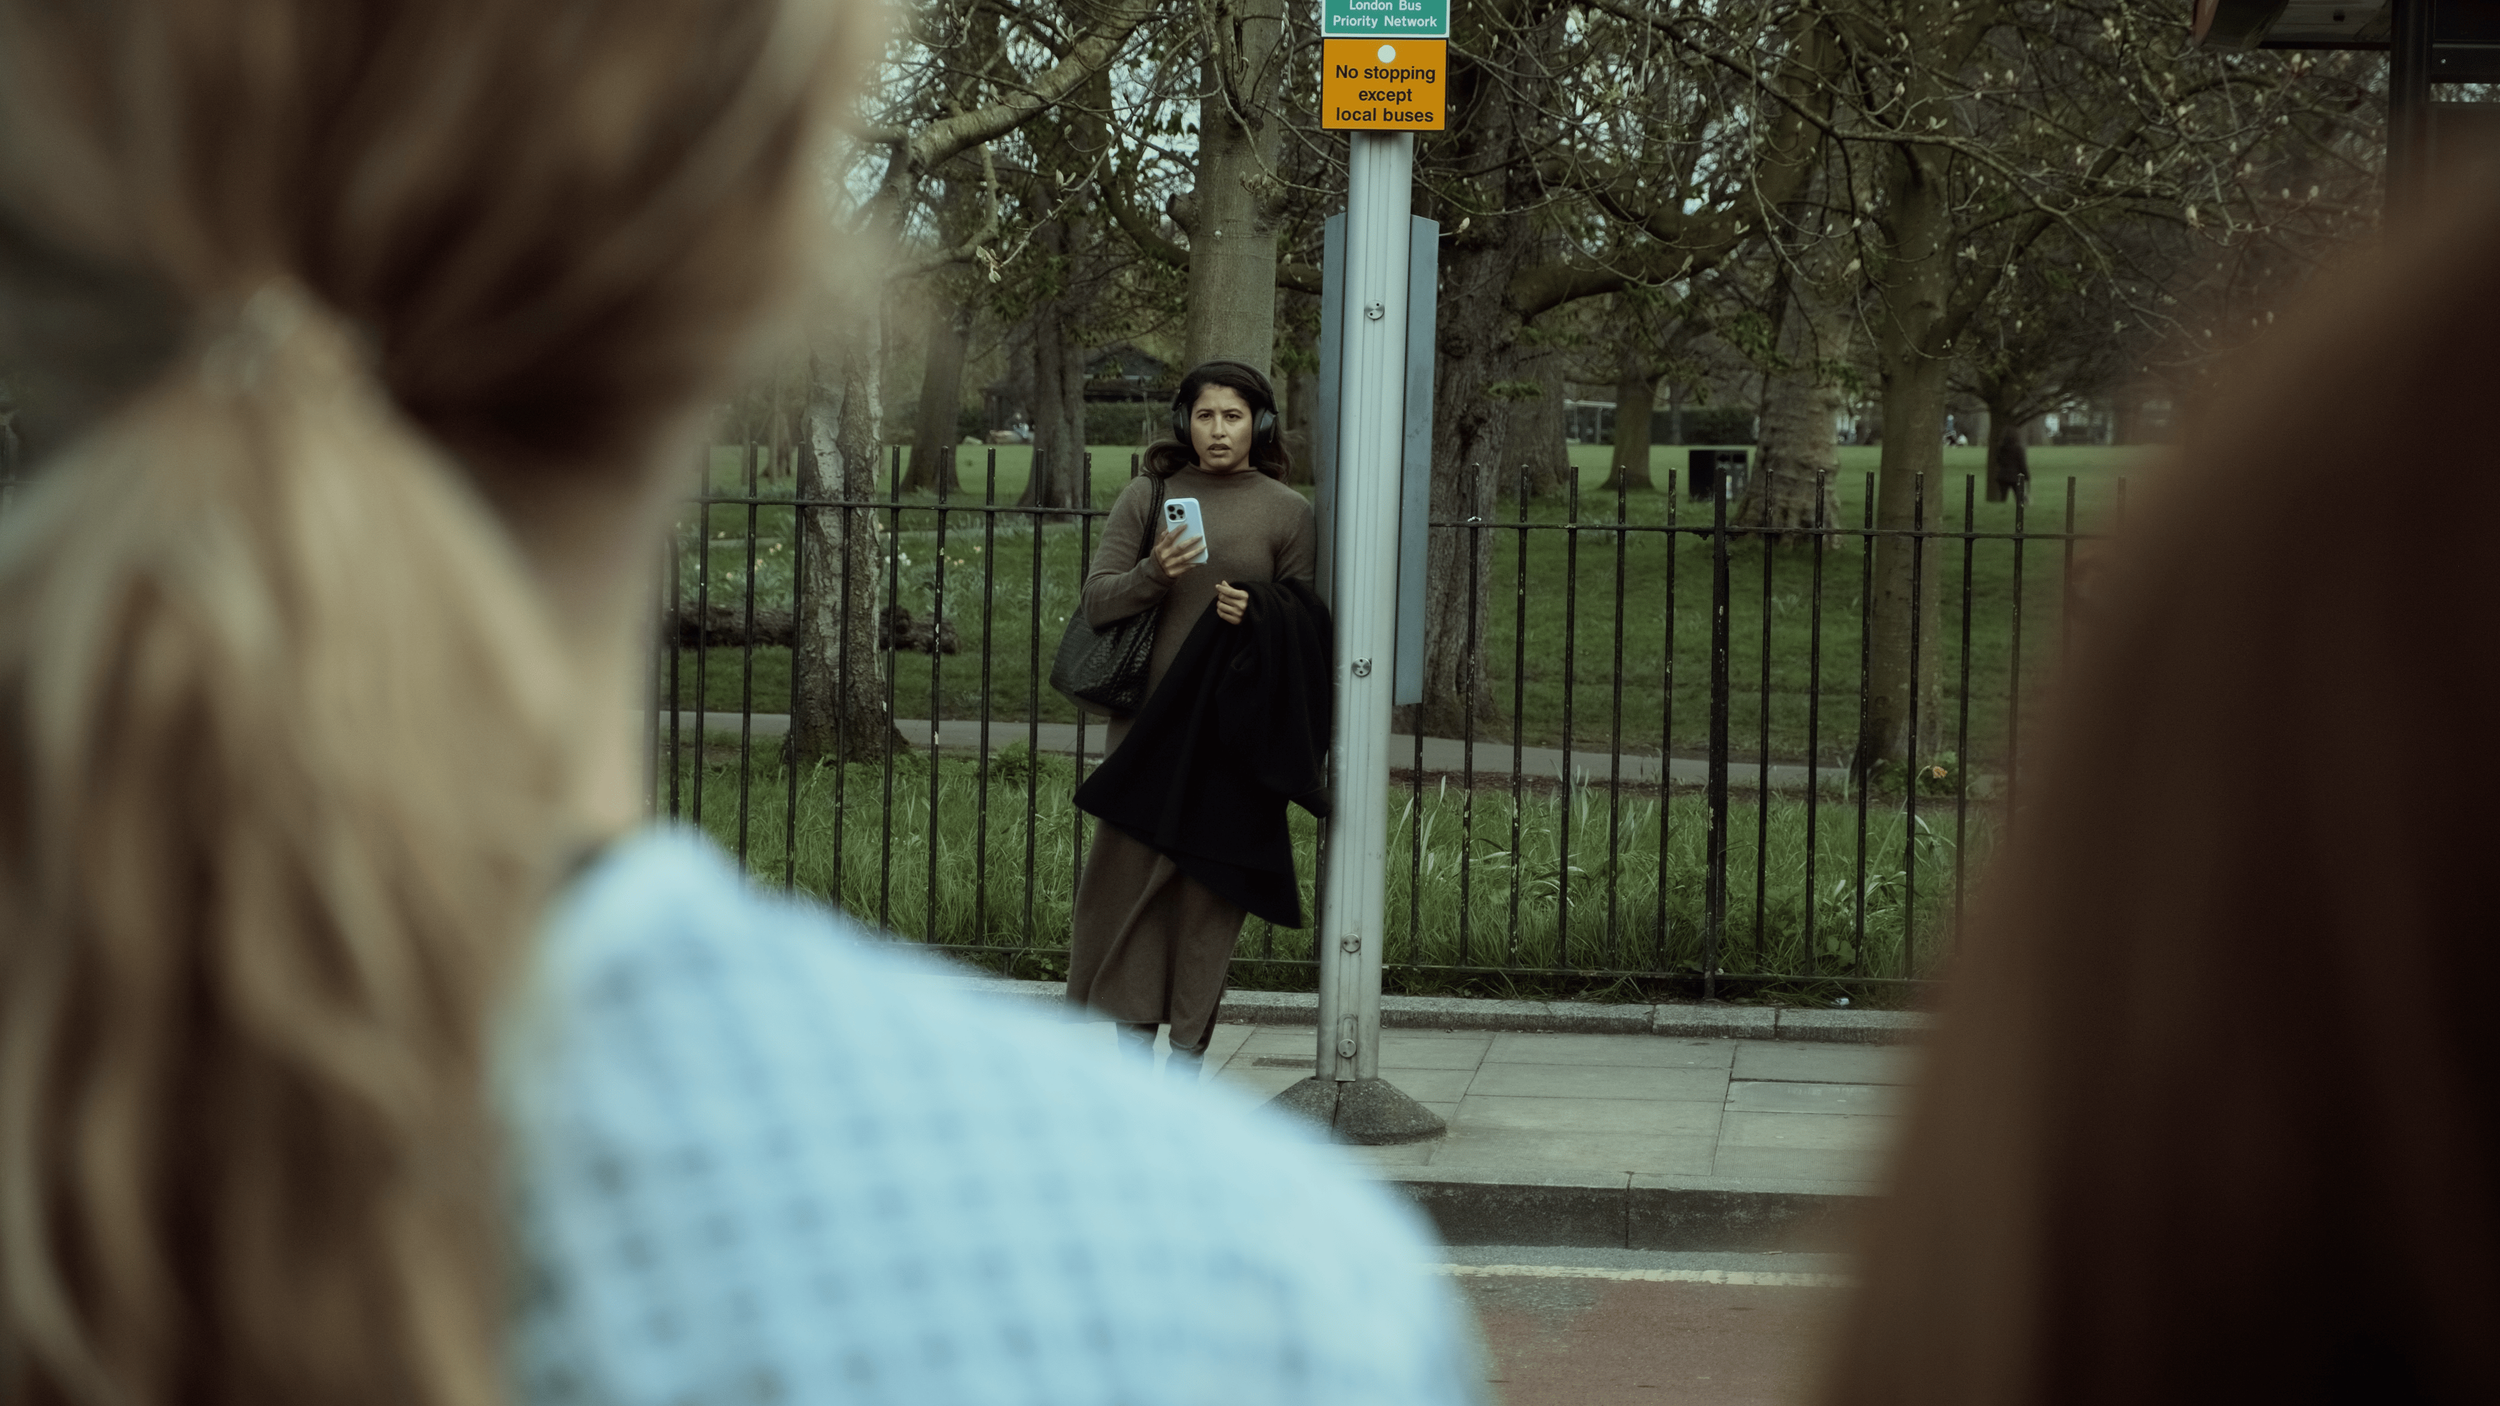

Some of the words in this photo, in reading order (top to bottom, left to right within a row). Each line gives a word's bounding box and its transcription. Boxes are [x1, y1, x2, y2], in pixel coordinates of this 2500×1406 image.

[1349, 0, 1393, 10] London
[1399, 0, 1422, 11] Bus
[1333, 15, 1378, 29] Priority
[1384, 16, 1437, 27] Network
[1336, 65, 1359, 79] No
[1364, 66, 1436, 84] stopping
[1358, 89, 1413, 105] except
[1336, 107, 1377, 121] local
[1383, 108, 1434, 122] buses
